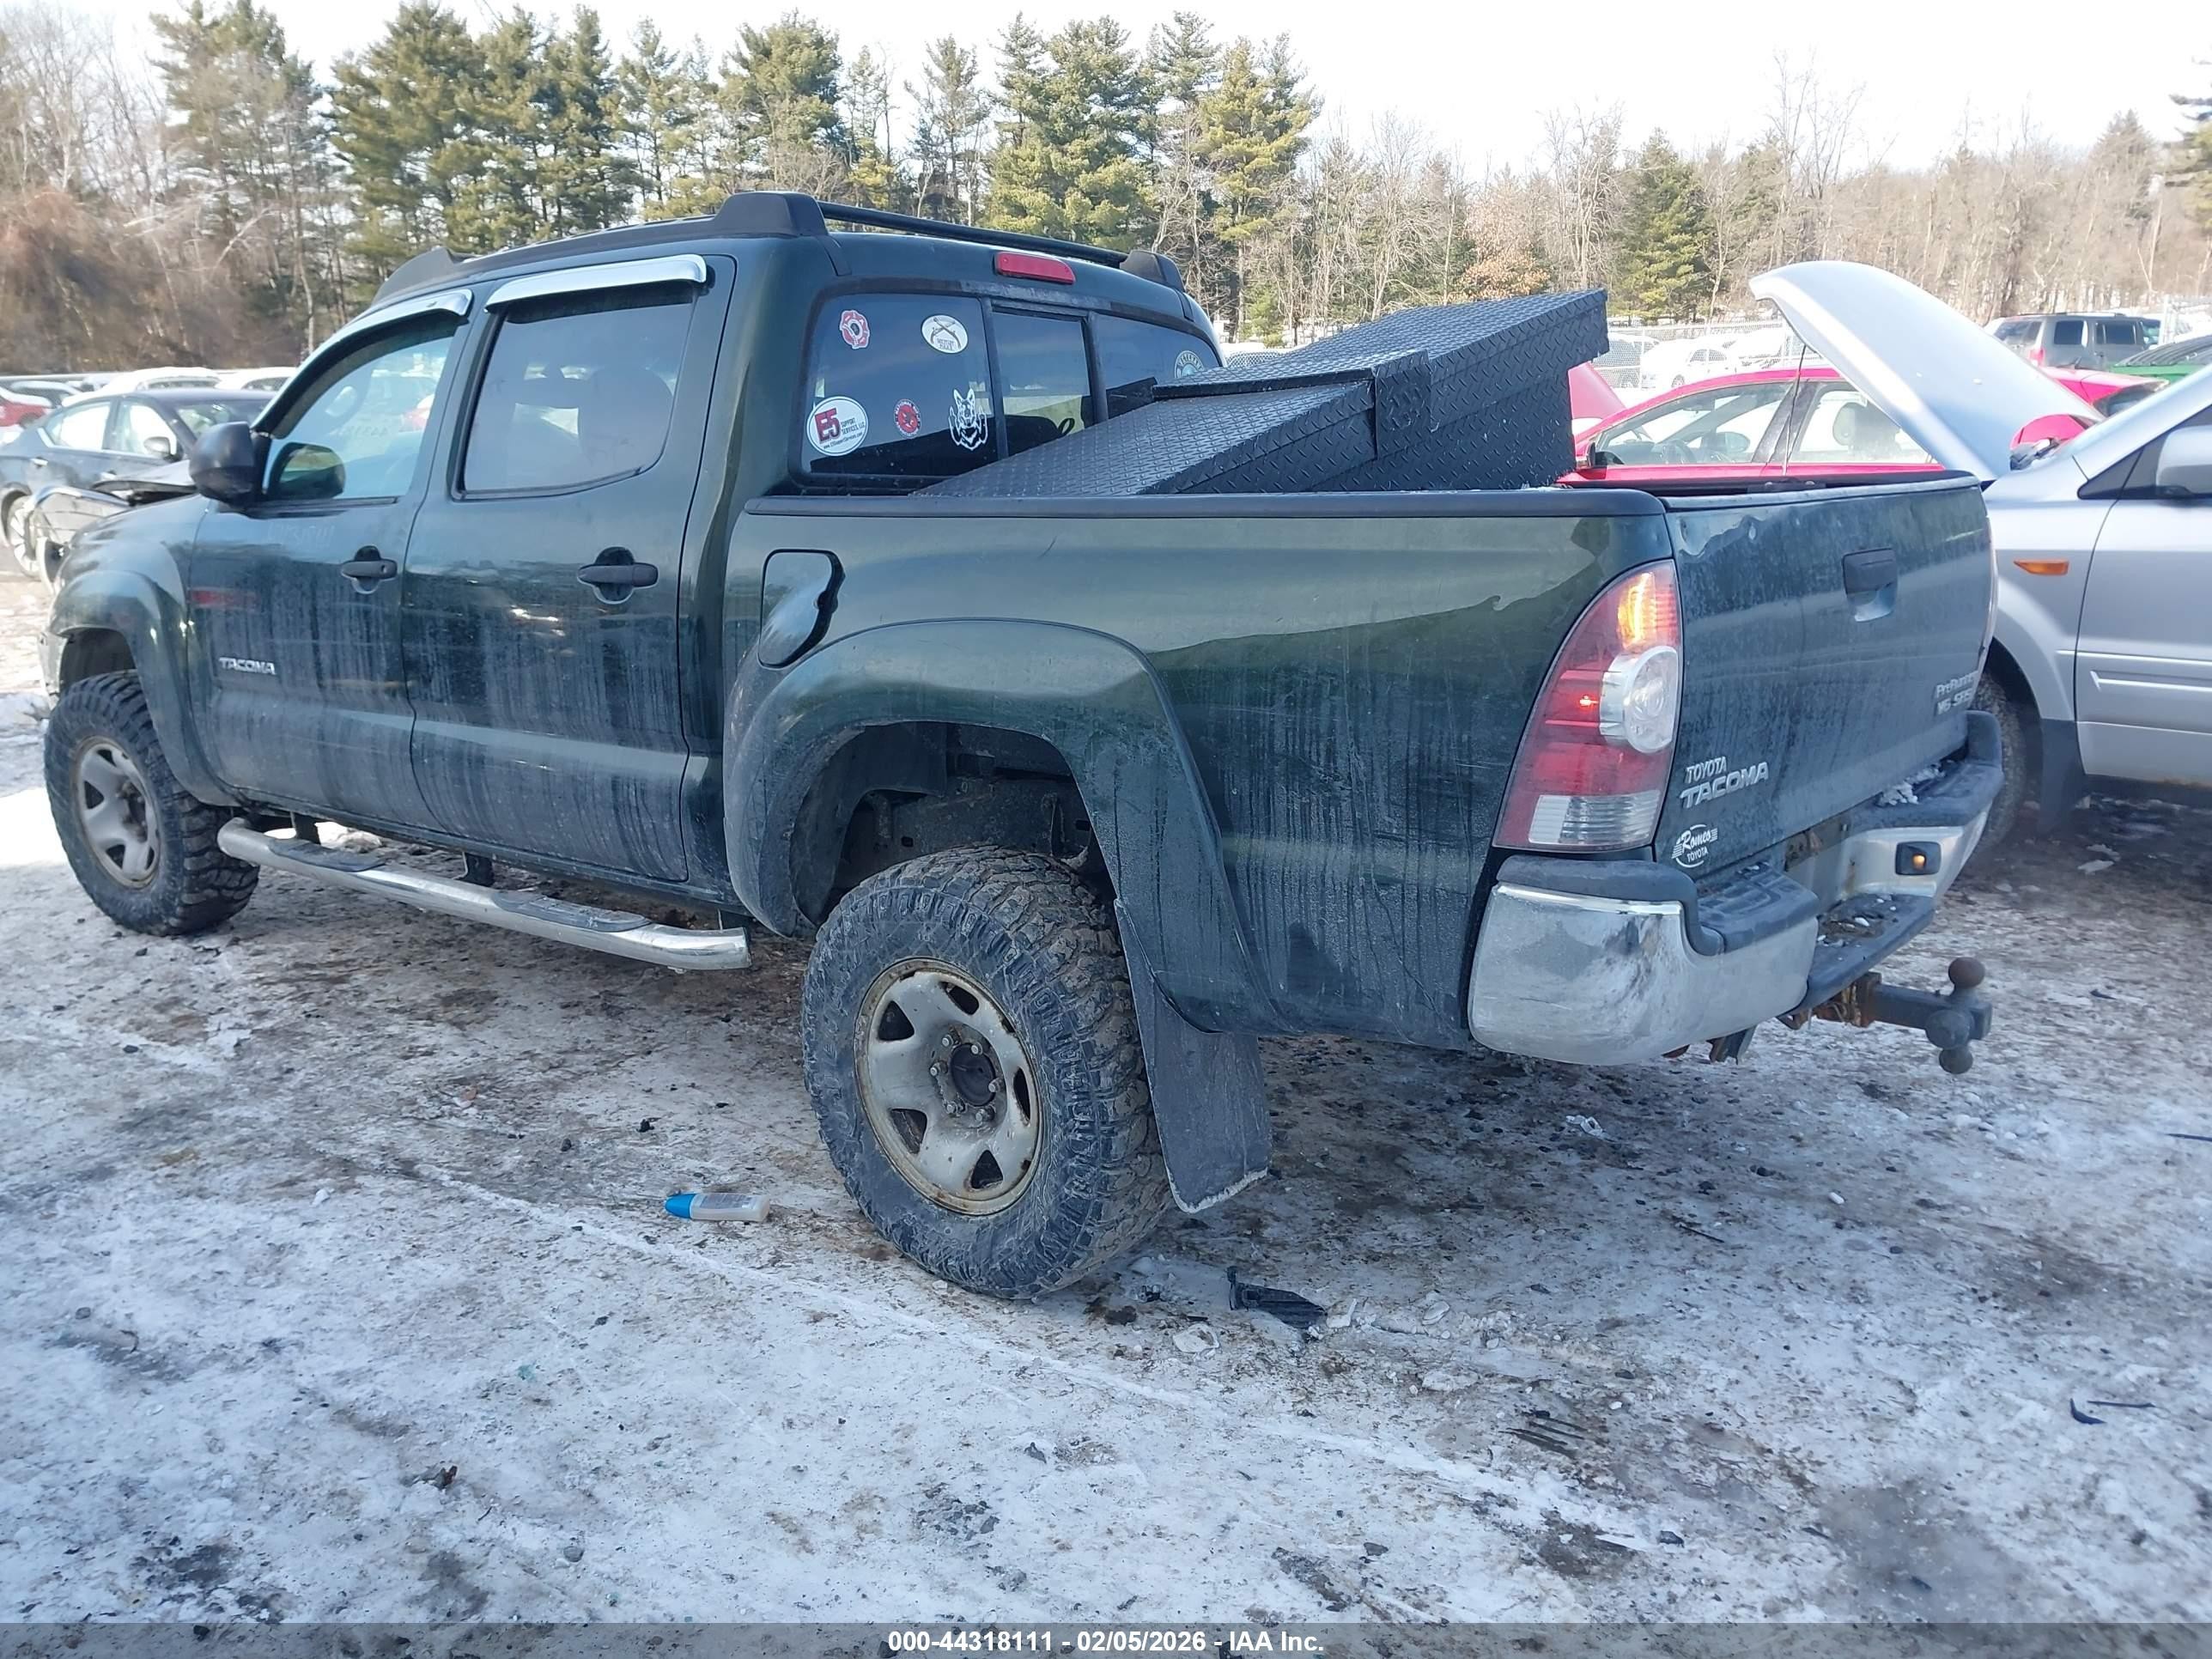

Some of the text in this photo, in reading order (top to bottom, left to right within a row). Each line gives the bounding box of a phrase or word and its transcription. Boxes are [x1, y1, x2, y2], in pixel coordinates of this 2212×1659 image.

[815, 407, 842, 442] E5
[218, 657, 277, 676] TACOMA
[1684, 756, 1727, 785] TOYOTA
[1679, 762, 1770, 809] TACOMA
[1686, 846, 1709, 863] TOYOTA
